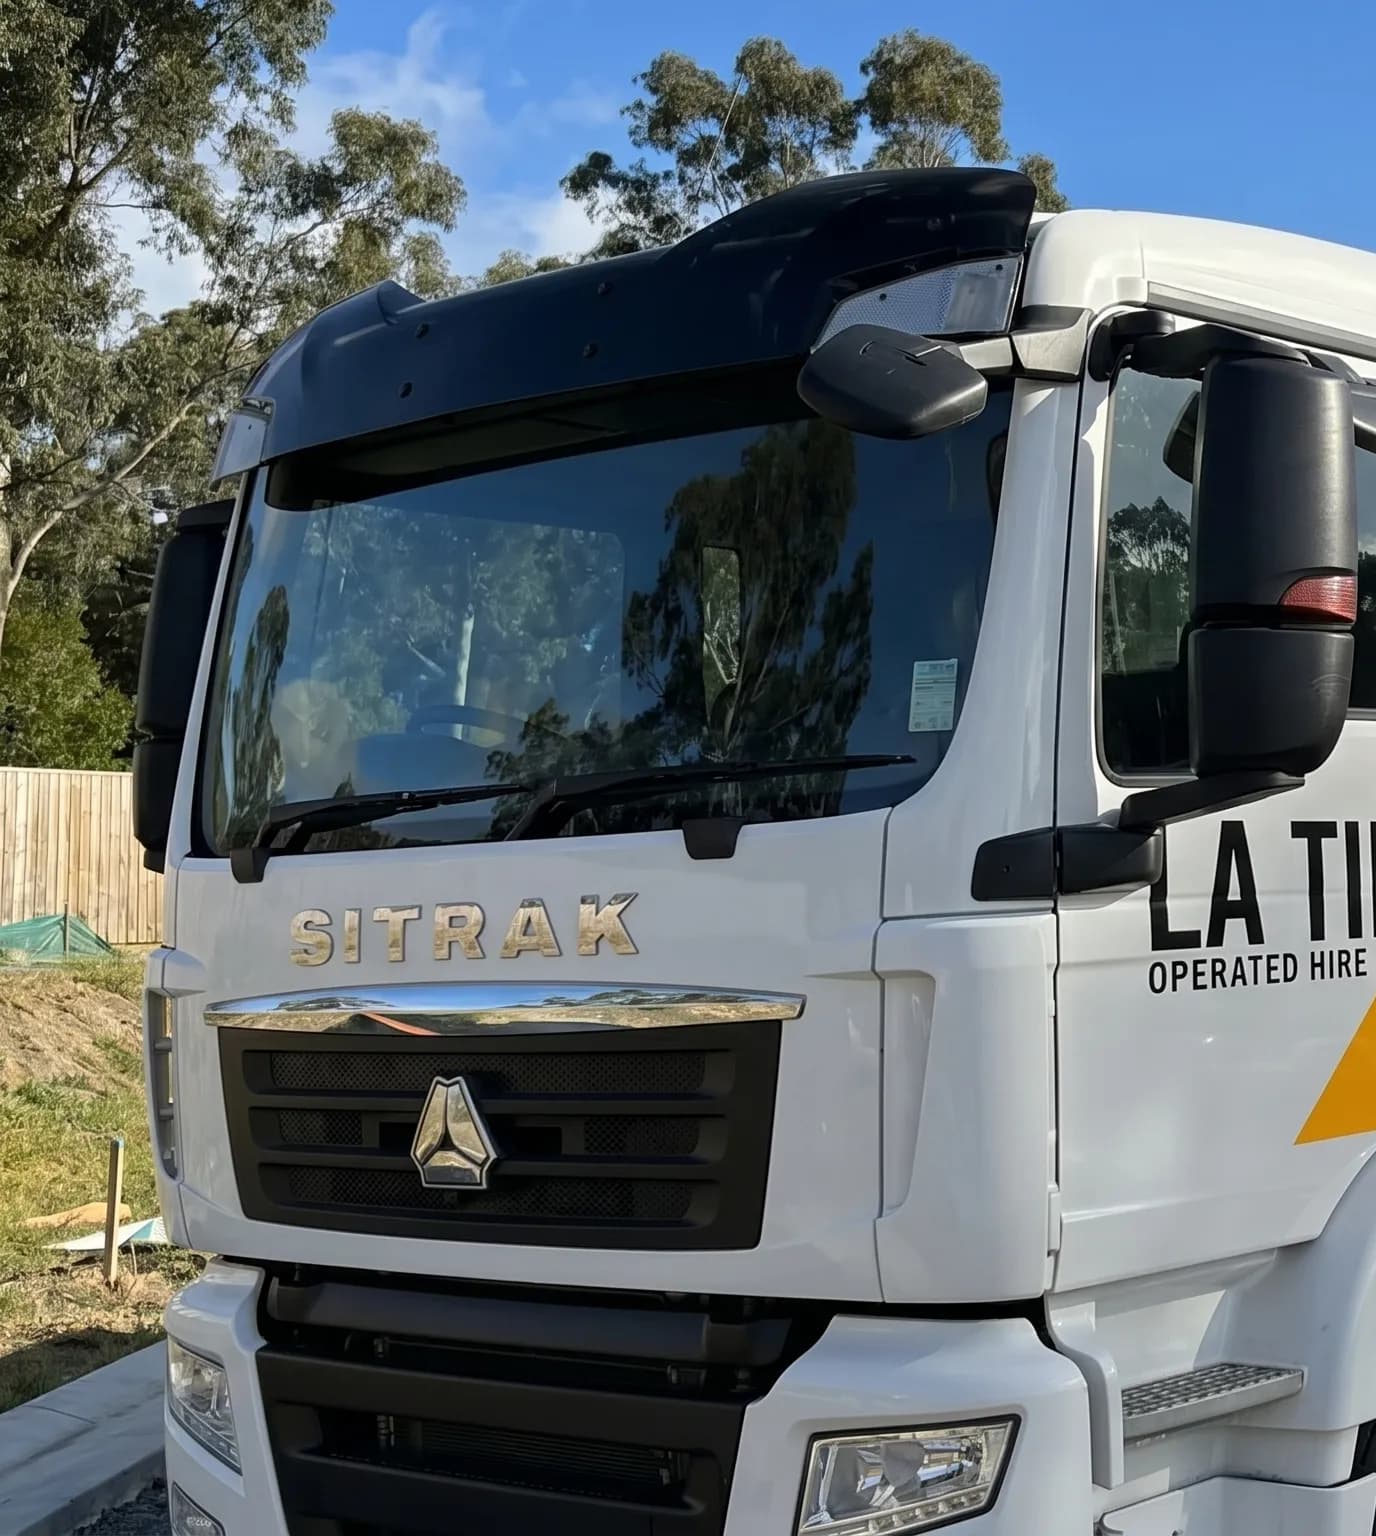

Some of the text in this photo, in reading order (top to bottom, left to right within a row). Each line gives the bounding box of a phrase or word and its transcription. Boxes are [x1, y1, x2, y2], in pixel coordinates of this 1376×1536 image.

[1150, 820, 1265, 951] LA
[289, 891, 640, 967] SITRAK
[1148, 947, 1368, 994] OPERATED HIRE
